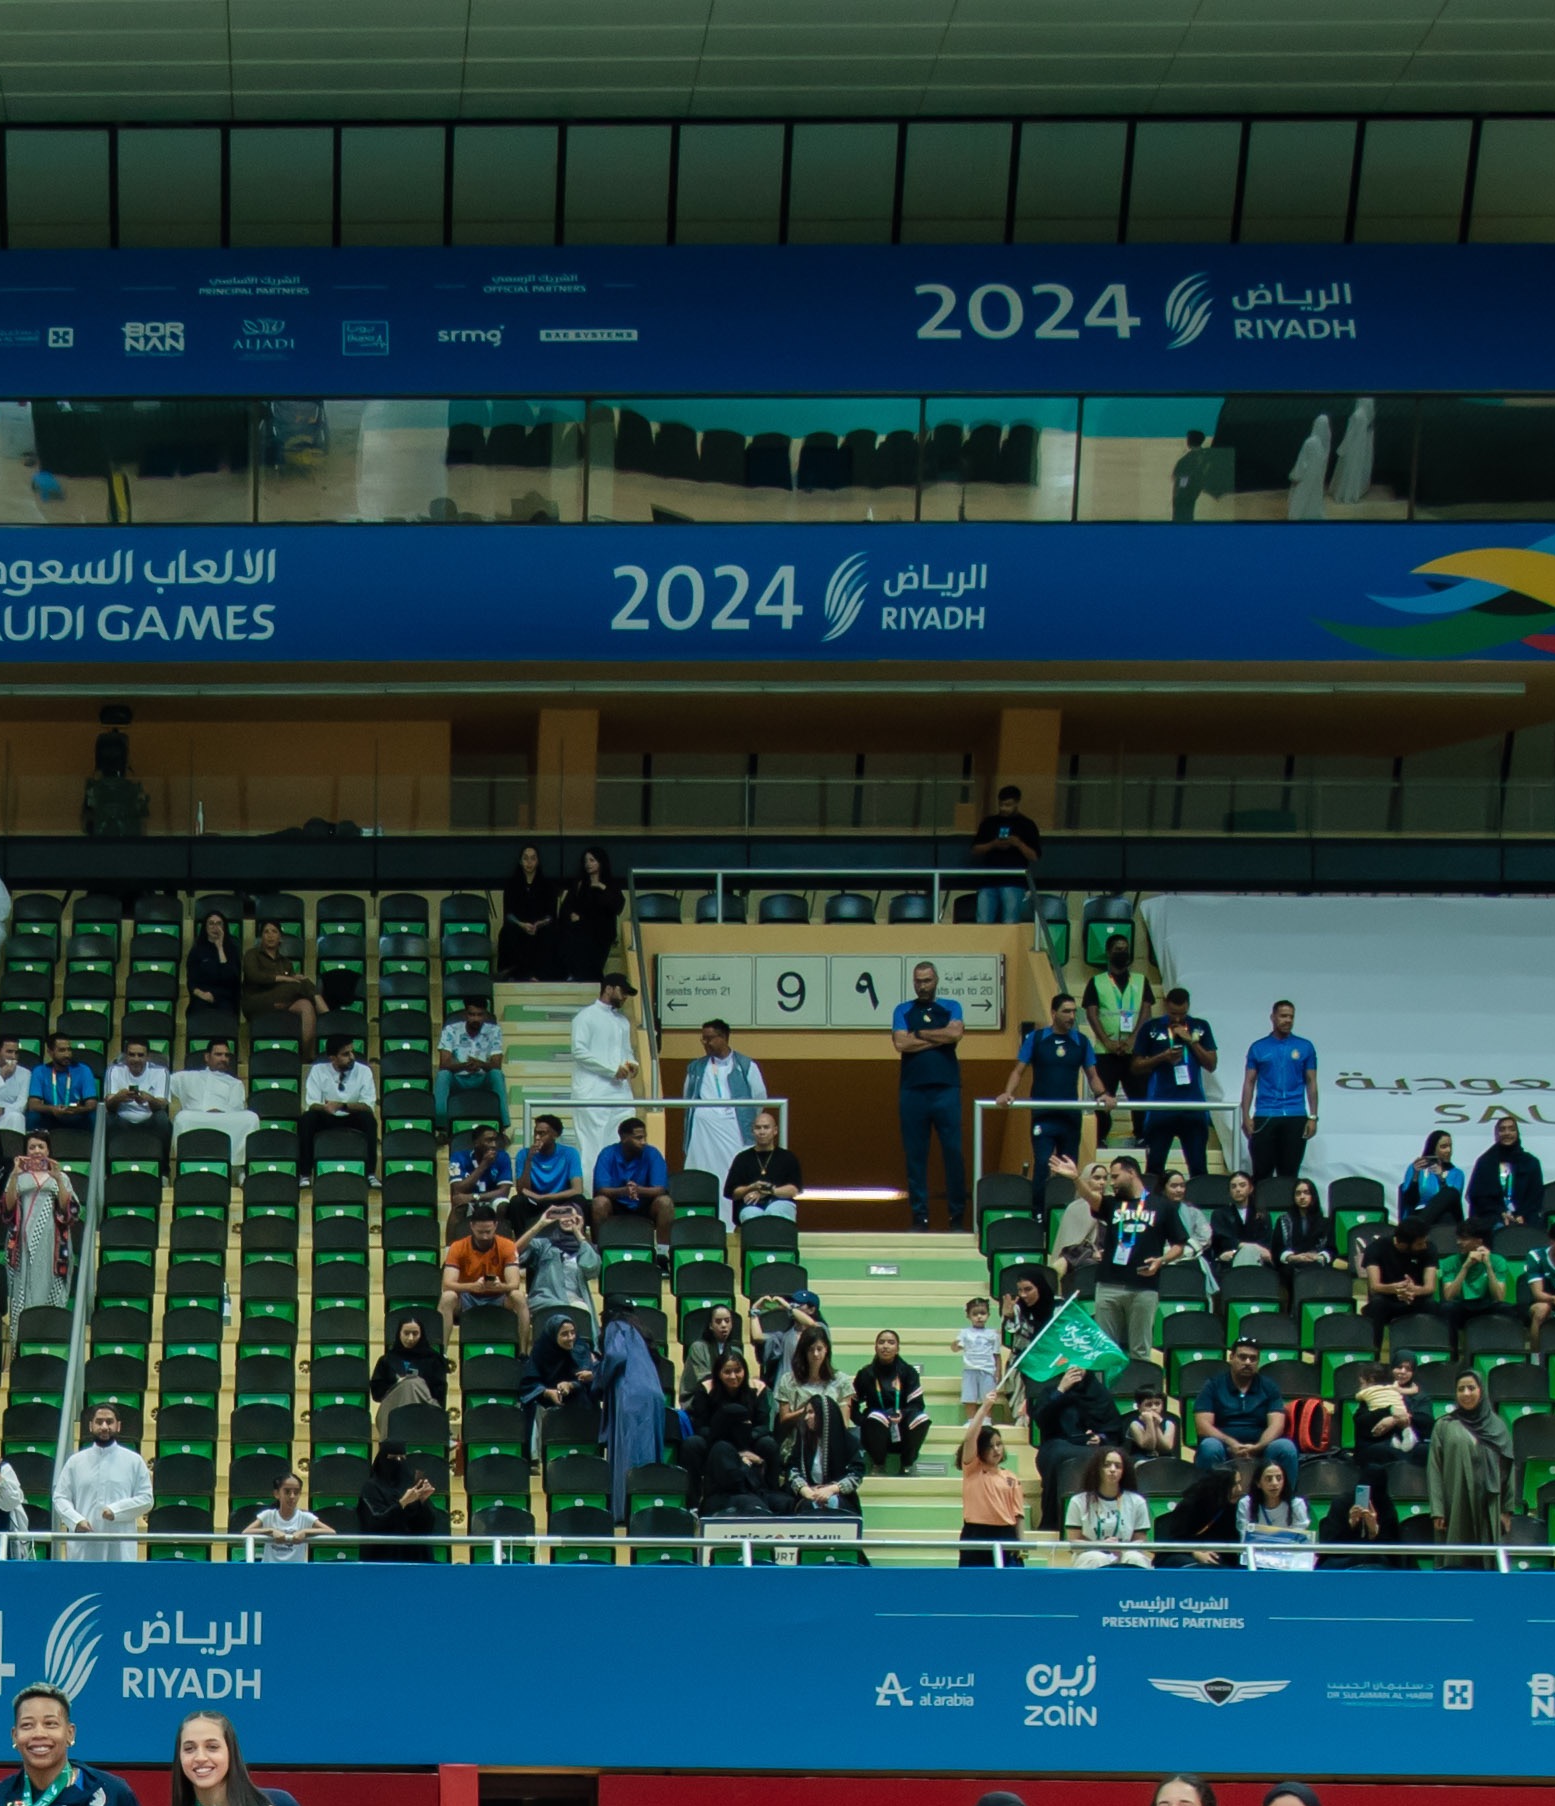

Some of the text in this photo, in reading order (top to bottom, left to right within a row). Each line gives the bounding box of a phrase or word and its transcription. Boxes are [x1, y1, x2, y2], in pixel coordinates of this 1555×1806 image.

[199, 286, 310, 296] PRINCIPAL PARTNERS
[483, 285, 586, 294] OFFICIAL PARTNERS
[1233, 283, 1351, 311] الرياض
[916, 284, 1140, 338] 2024
[125, 322, 185, 337] BOR
[1235, 319, 1355, 338] RIYADH
[125, 337, 185, 351] NAN
[233, 338, 295, 350] ALJADI
[144, 549, 275, 593] الالعاب
[884, 564, 987, 597] الرياض
[612, 565, 803, 630] 2024
[98, 604, 275, 640] GAMES
[882, 607, 984, 629] RIYADH
[665, 986, 731, 996] seats from 21
[777, 972, 805, 1012] 9
[856, 972, 879, 1009] ٩
[951, 986, 965, 998] up
[966, 985, 977, 996] to
[979, 985, 994, 996] 20
[1179, 1597, 1229, 1614] الشريك
[1101, 1616, 1245, 1629] PRESENTING PARTNERS
[124, 1611, 261, 1656] الرياض
[123, 1667, 261, 1699] RIYADH
[919, 1672, 975, 1691] العربية
[1025, 1654, 1097, 1697] زين
[933, 1692, 975, 1707] arabia
